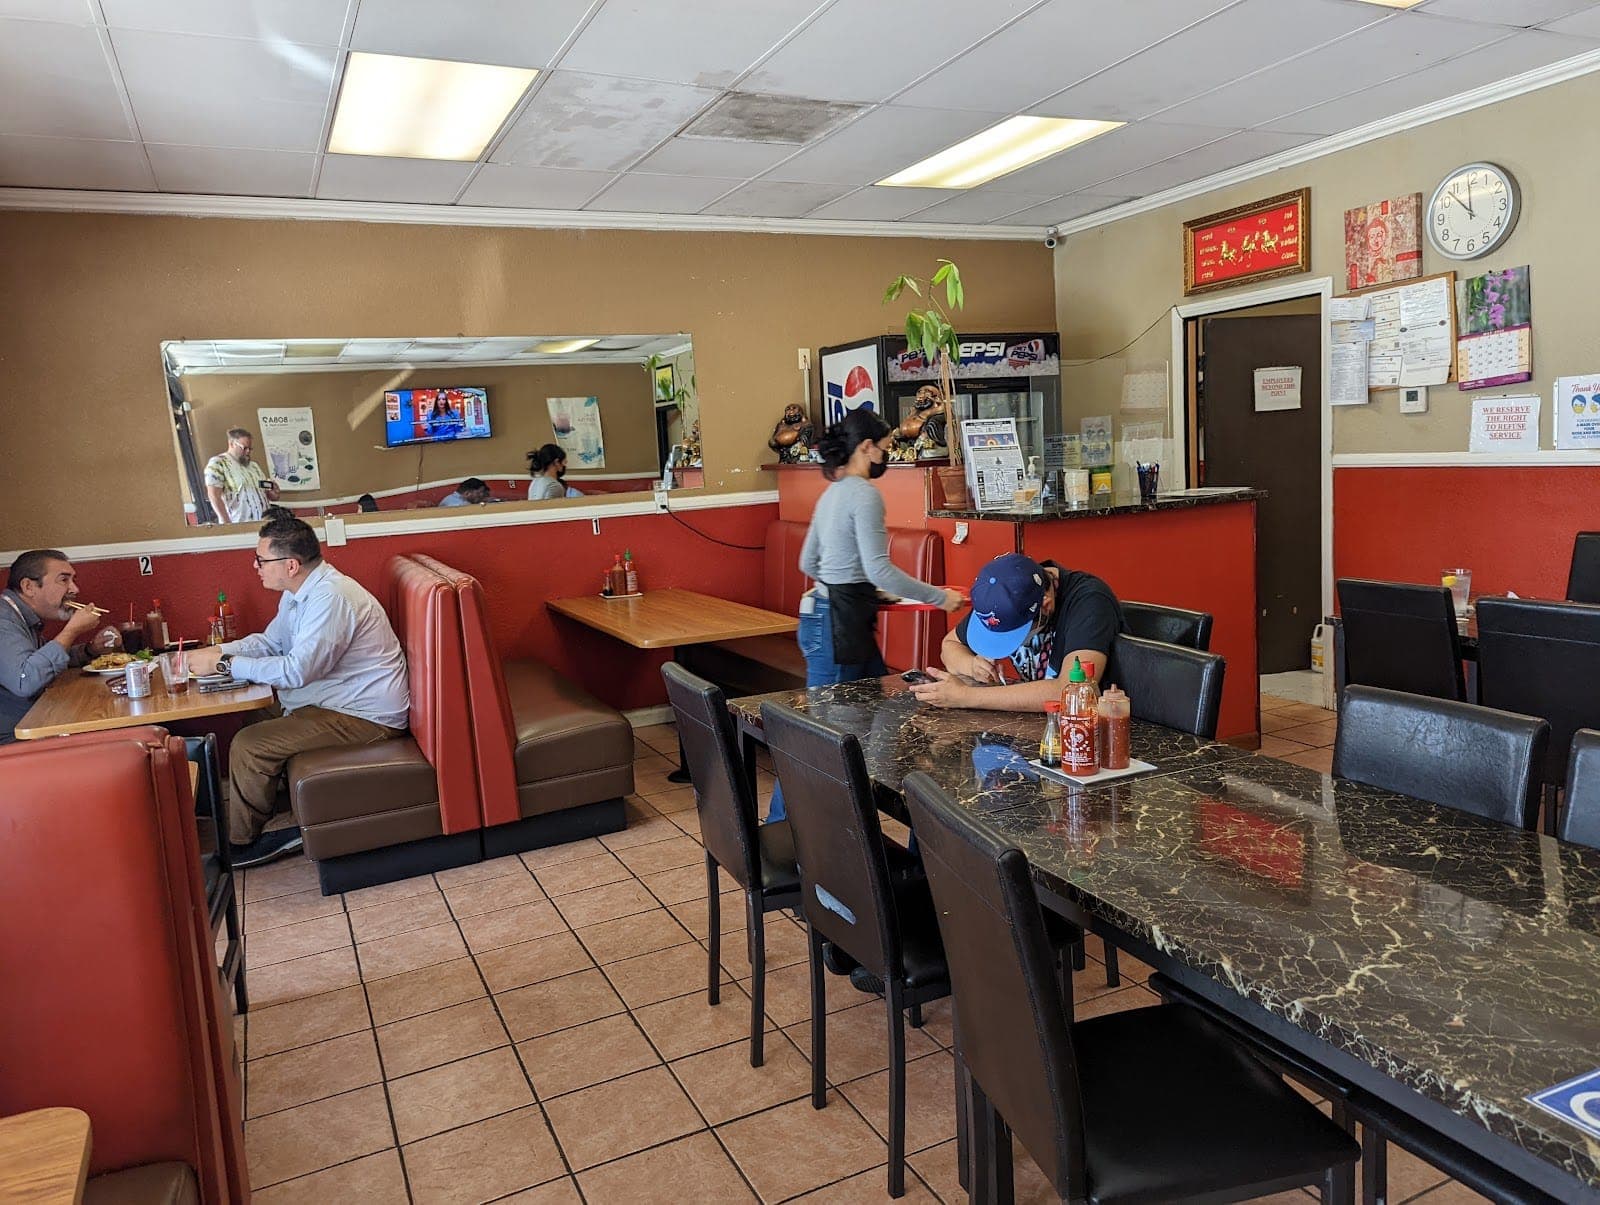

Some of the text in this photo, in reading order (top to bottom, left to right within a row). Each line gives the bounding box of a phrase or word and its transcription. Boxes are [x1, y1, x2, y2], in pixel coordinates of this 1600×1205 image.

[1484, 174, 1488, 185] 1
[1452, 183, 1459, 194] 11
[1494, 181, 1502, 194] 2
[1440, 196, 1451, 209] 10
[1499, 198, 1507, 211] 3
[1437, 213, 1445, 226] 9
[1493, 216, 1501, 228] 4
[1441, 229, 1450, 241] 8
[1482, 231, 1490, 244] 5
[1453, 238, 1461, 251] 7
[1466, 238, 1475, 251] 6
[1572, 383, 1591, 393] Thank
[1503, 414, 1527, 422] RIGHT
[1497, 423, 1527, 431] REFUSE
[1489, 431, 1522, 440] SERVICE
[594, 519, 598, 533] 1
[141, 556, 152, 574] 2
